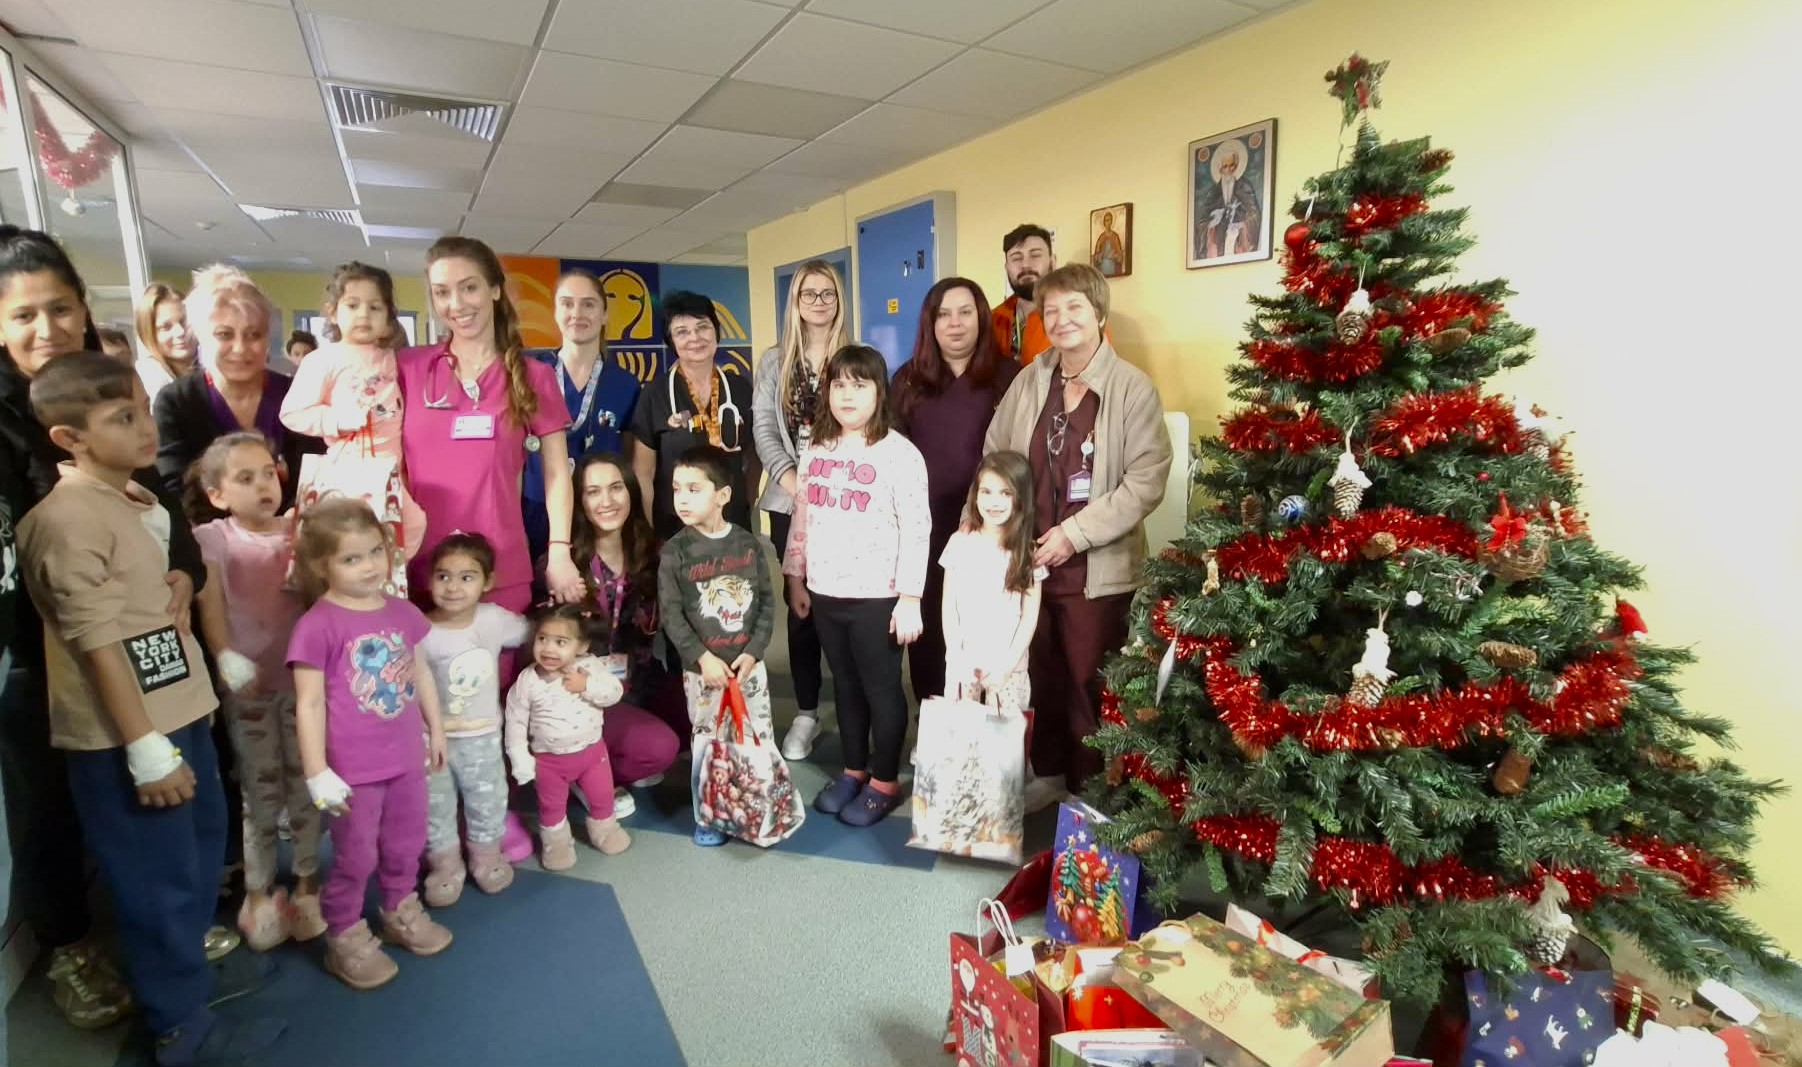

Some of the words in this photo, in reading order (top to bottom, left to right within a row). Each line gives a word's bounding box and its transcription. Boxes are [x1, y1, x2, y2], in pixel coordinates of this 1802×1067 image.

[131, 629, 176, 650] NEW
[135, 639, 179, 660] YORK
[139, 647, 180, 670] CITY
